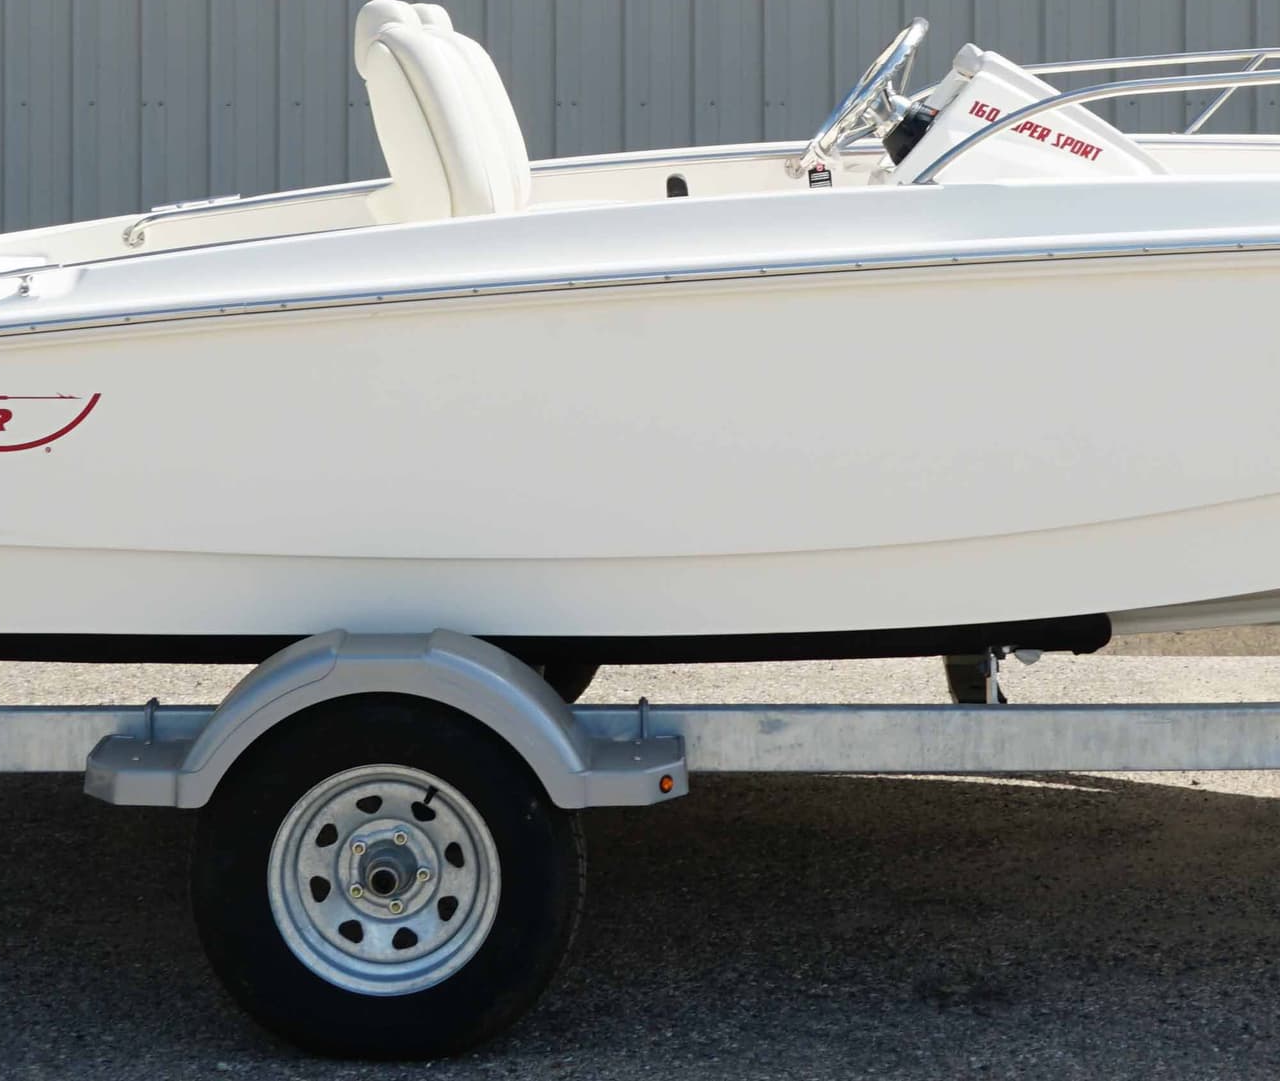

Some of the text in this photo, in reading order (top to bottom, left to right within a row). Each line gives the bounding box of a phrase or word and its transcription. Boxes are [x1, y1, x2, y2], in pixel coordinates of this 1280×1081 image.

[969, 100, 1104, 162] 160 PER SPORT
